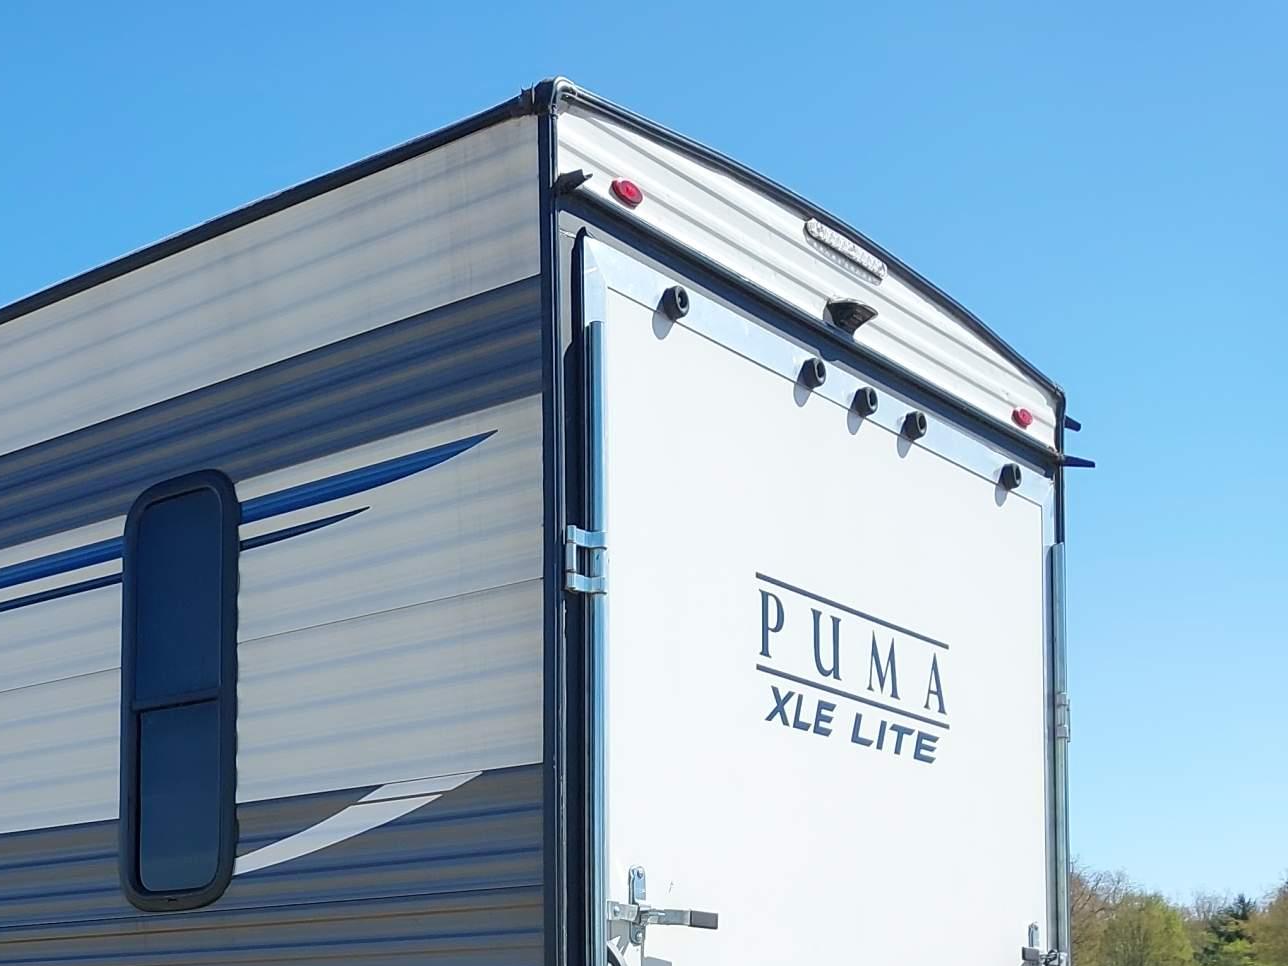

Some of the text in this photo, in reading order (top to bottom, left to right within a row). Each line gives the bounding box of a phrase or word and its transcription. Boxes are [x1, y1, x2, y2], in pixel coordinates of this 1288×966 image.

[758, 588, 948, 716] PUMA
[764, 685, 940, 764] XLE LITE
